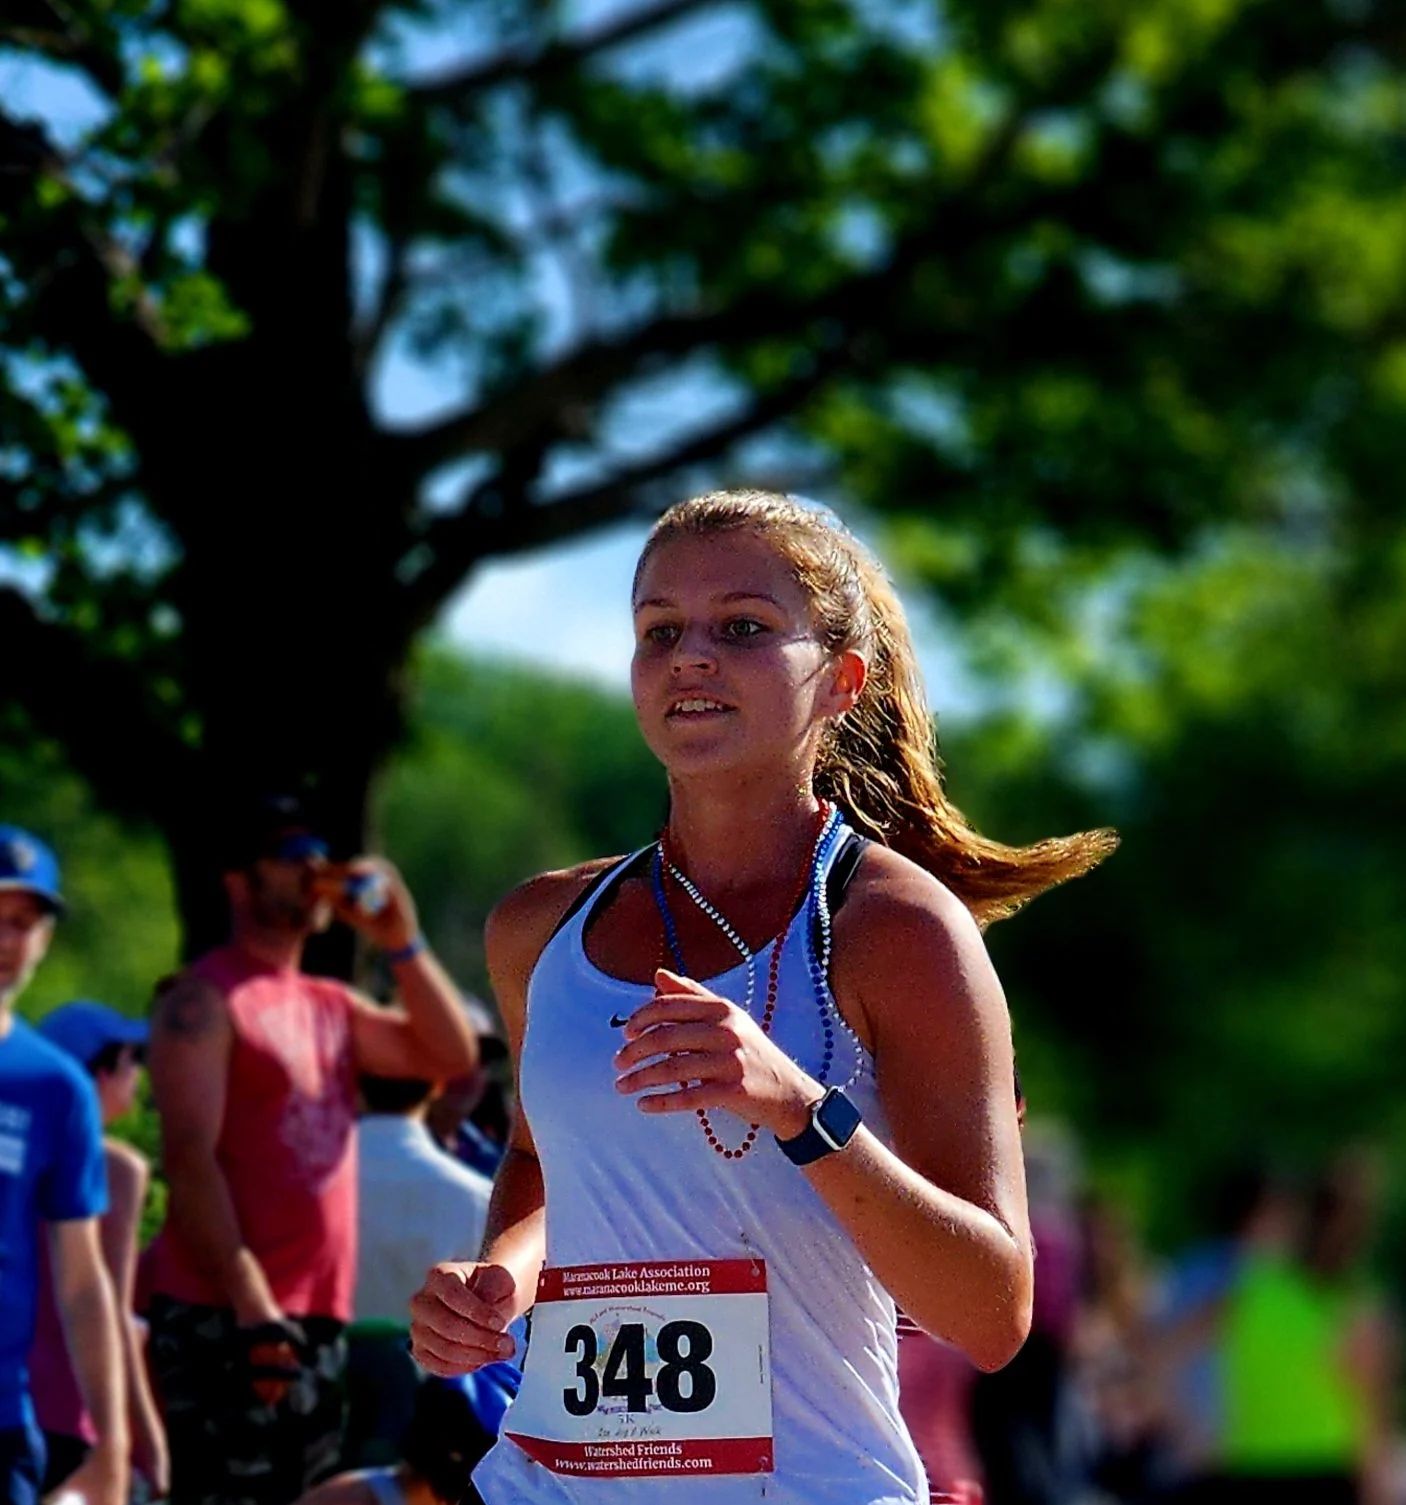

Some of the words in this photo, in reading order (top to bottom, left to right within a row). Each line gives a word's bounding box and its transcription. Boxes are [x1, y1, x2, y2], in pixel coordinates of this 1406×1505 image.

[563, 1268, 611, 1283] Maranacook
[612, 1266, 637, 1280] Lake
[640, 1264, 710, 1278] Association
[563, 1280, 710, 1297] www.maranacooklakeme.org
[563, 1320, 717, 1416] 348
[617, 1414, 635, 1424] 5K
[584, 1444, 635, 1457] Watershed
[637, 1442, 683, 1456] Friends
